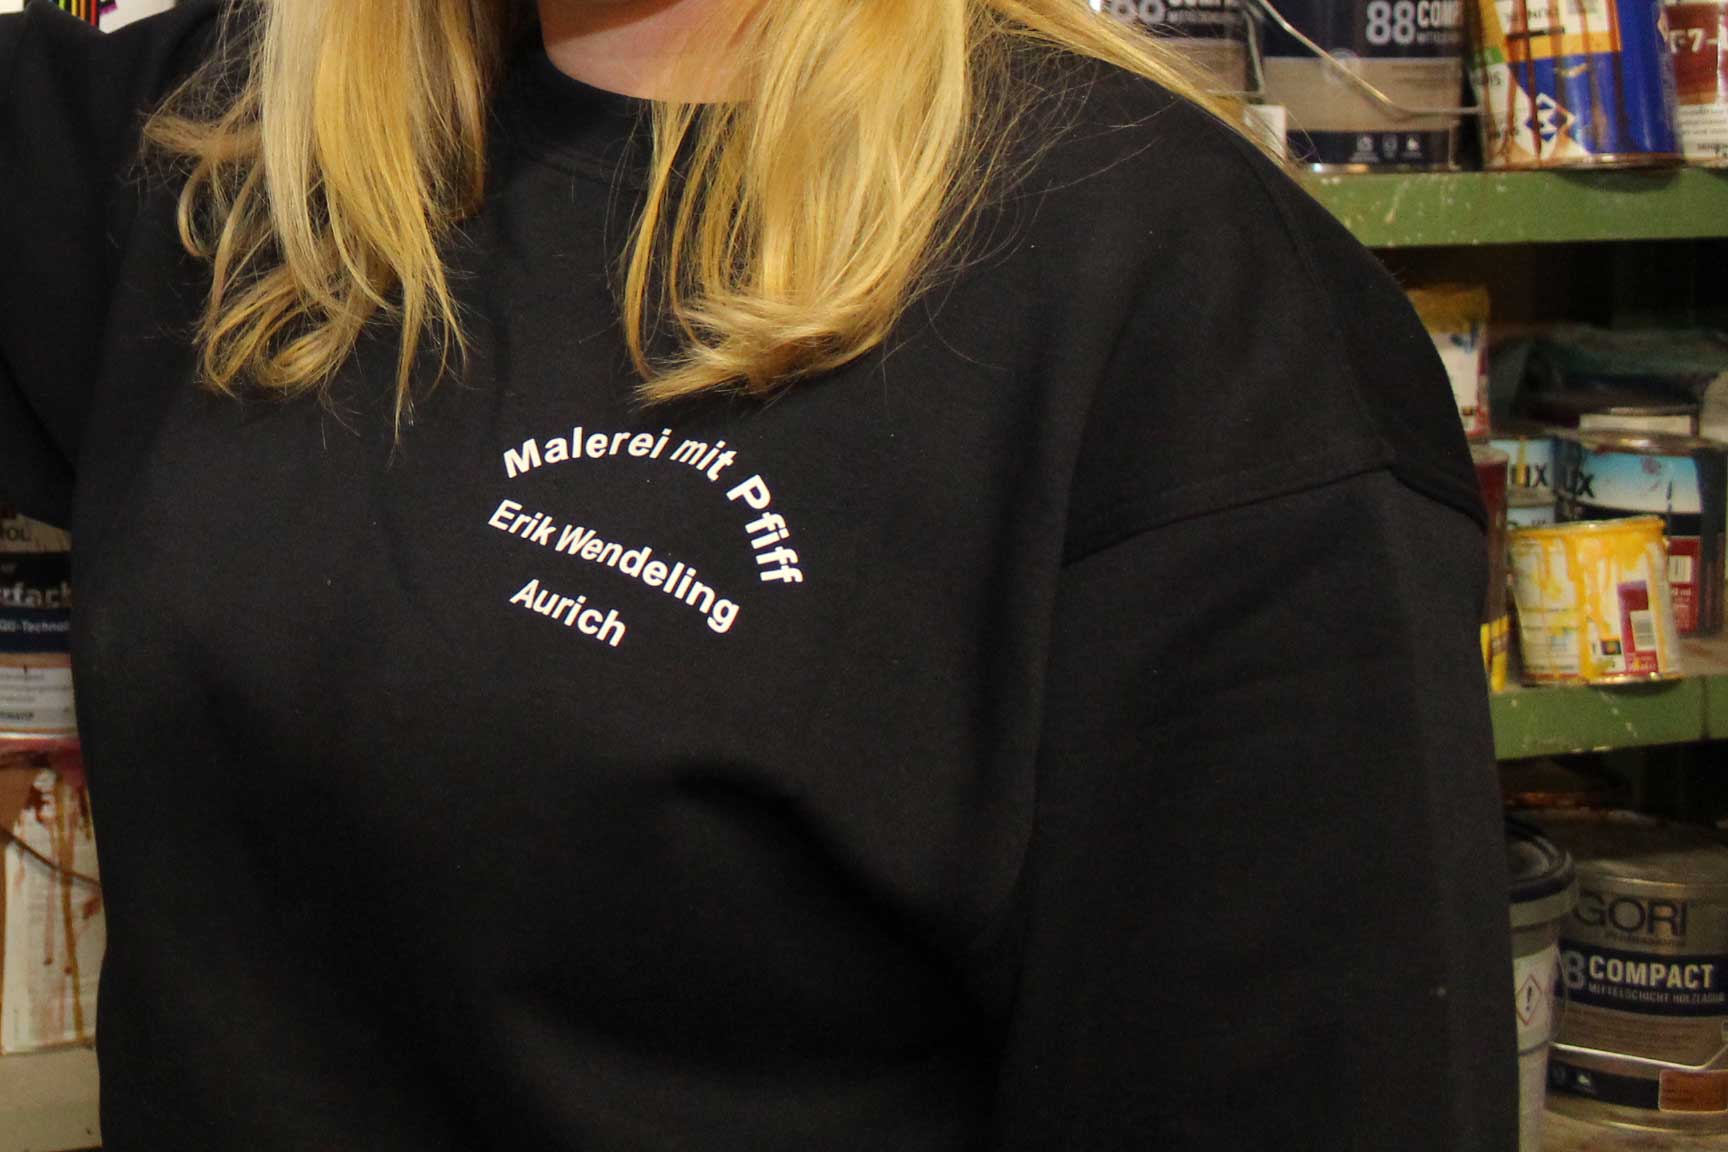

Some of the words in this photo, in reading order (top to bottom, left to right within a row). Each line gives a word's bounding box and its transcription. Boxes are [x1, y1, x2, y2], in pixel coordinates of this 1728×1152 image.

[1366, 0, 1416, 46] 88
[502, 426, 673, 480] Malerei
[669, 430, 737, 482] mit
[725, 474, 804, 584] Pfiff
[487, 499, 558, 546] Erik
[554, 523, 740, 634] Wendeling
[509, 578, 627, 648] Aurich
[1575, 895, 1689, 937] GORI
[1588, 954, 1714, 990] COMPACT
